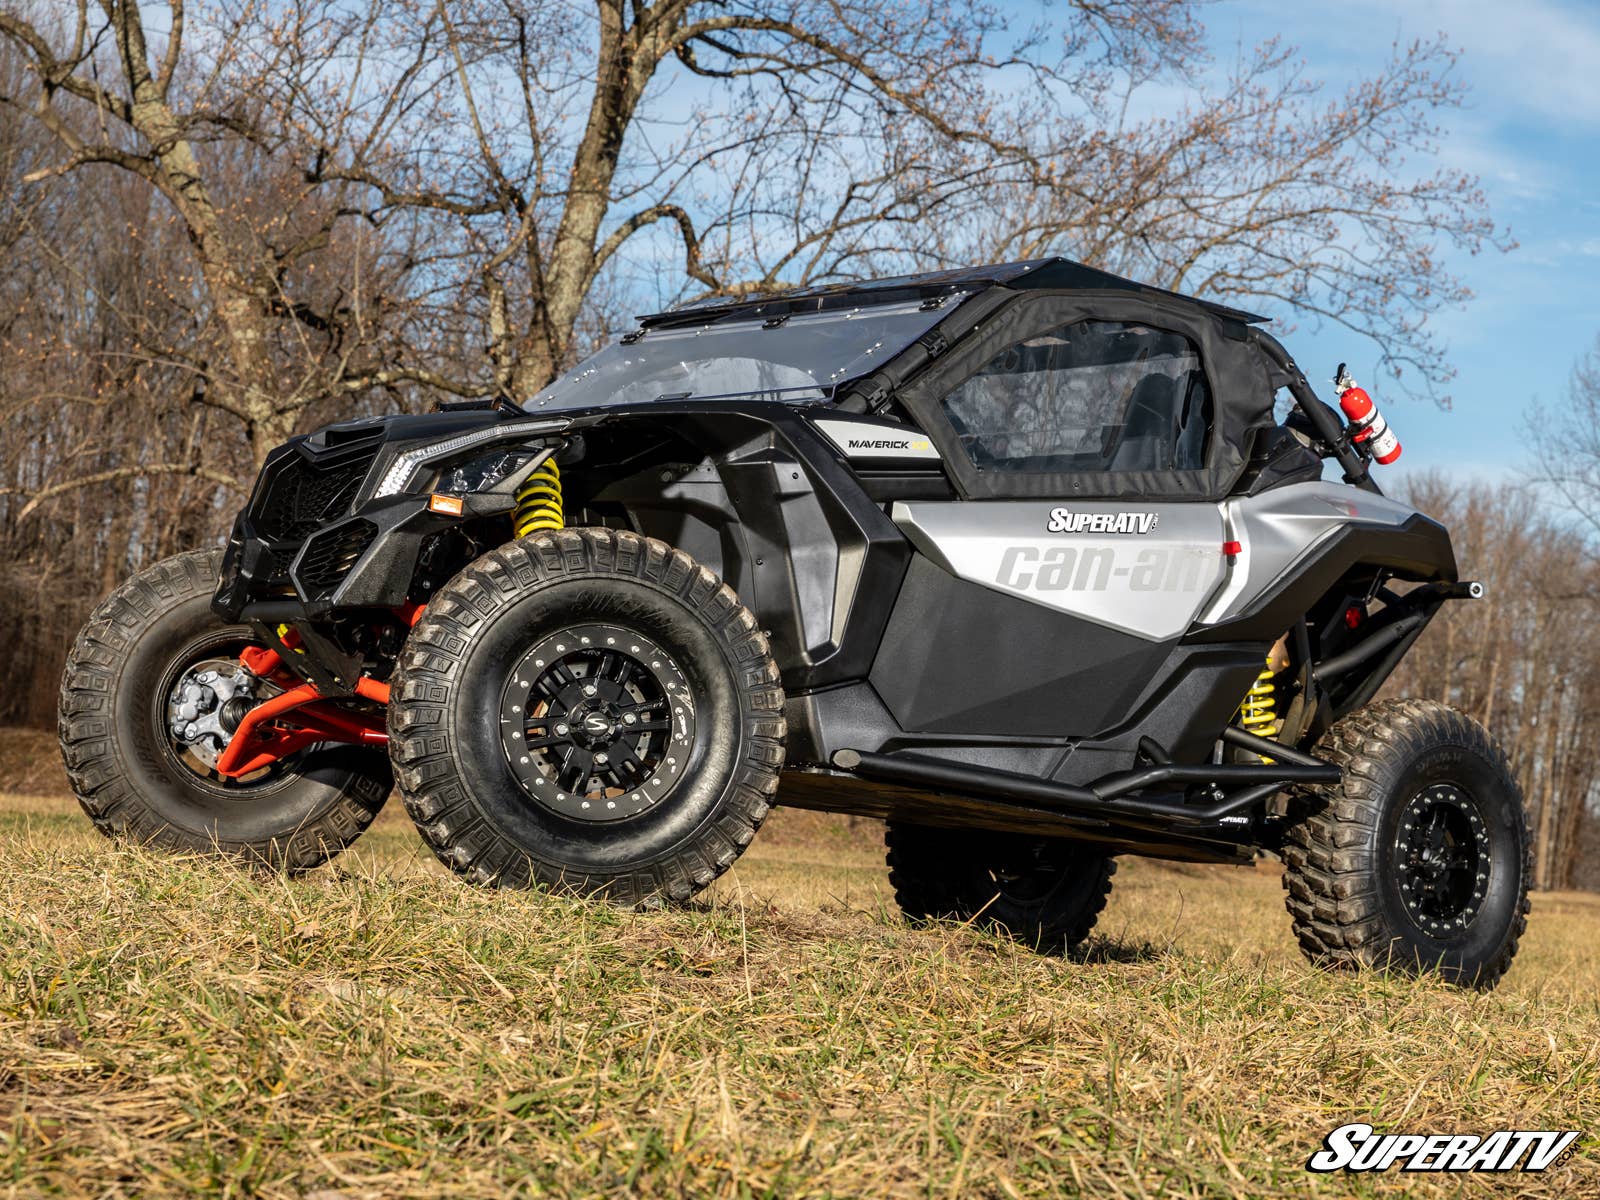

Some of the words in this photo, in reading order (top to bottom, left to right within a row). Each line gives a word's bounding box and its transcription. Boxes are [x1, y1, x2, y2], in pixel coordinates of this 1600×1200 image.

[848, 440, 909, 450] MAVERICK
[1048, 508, 1154, 535] SUPERATV
[995, 546, 1224, 593] can-am
